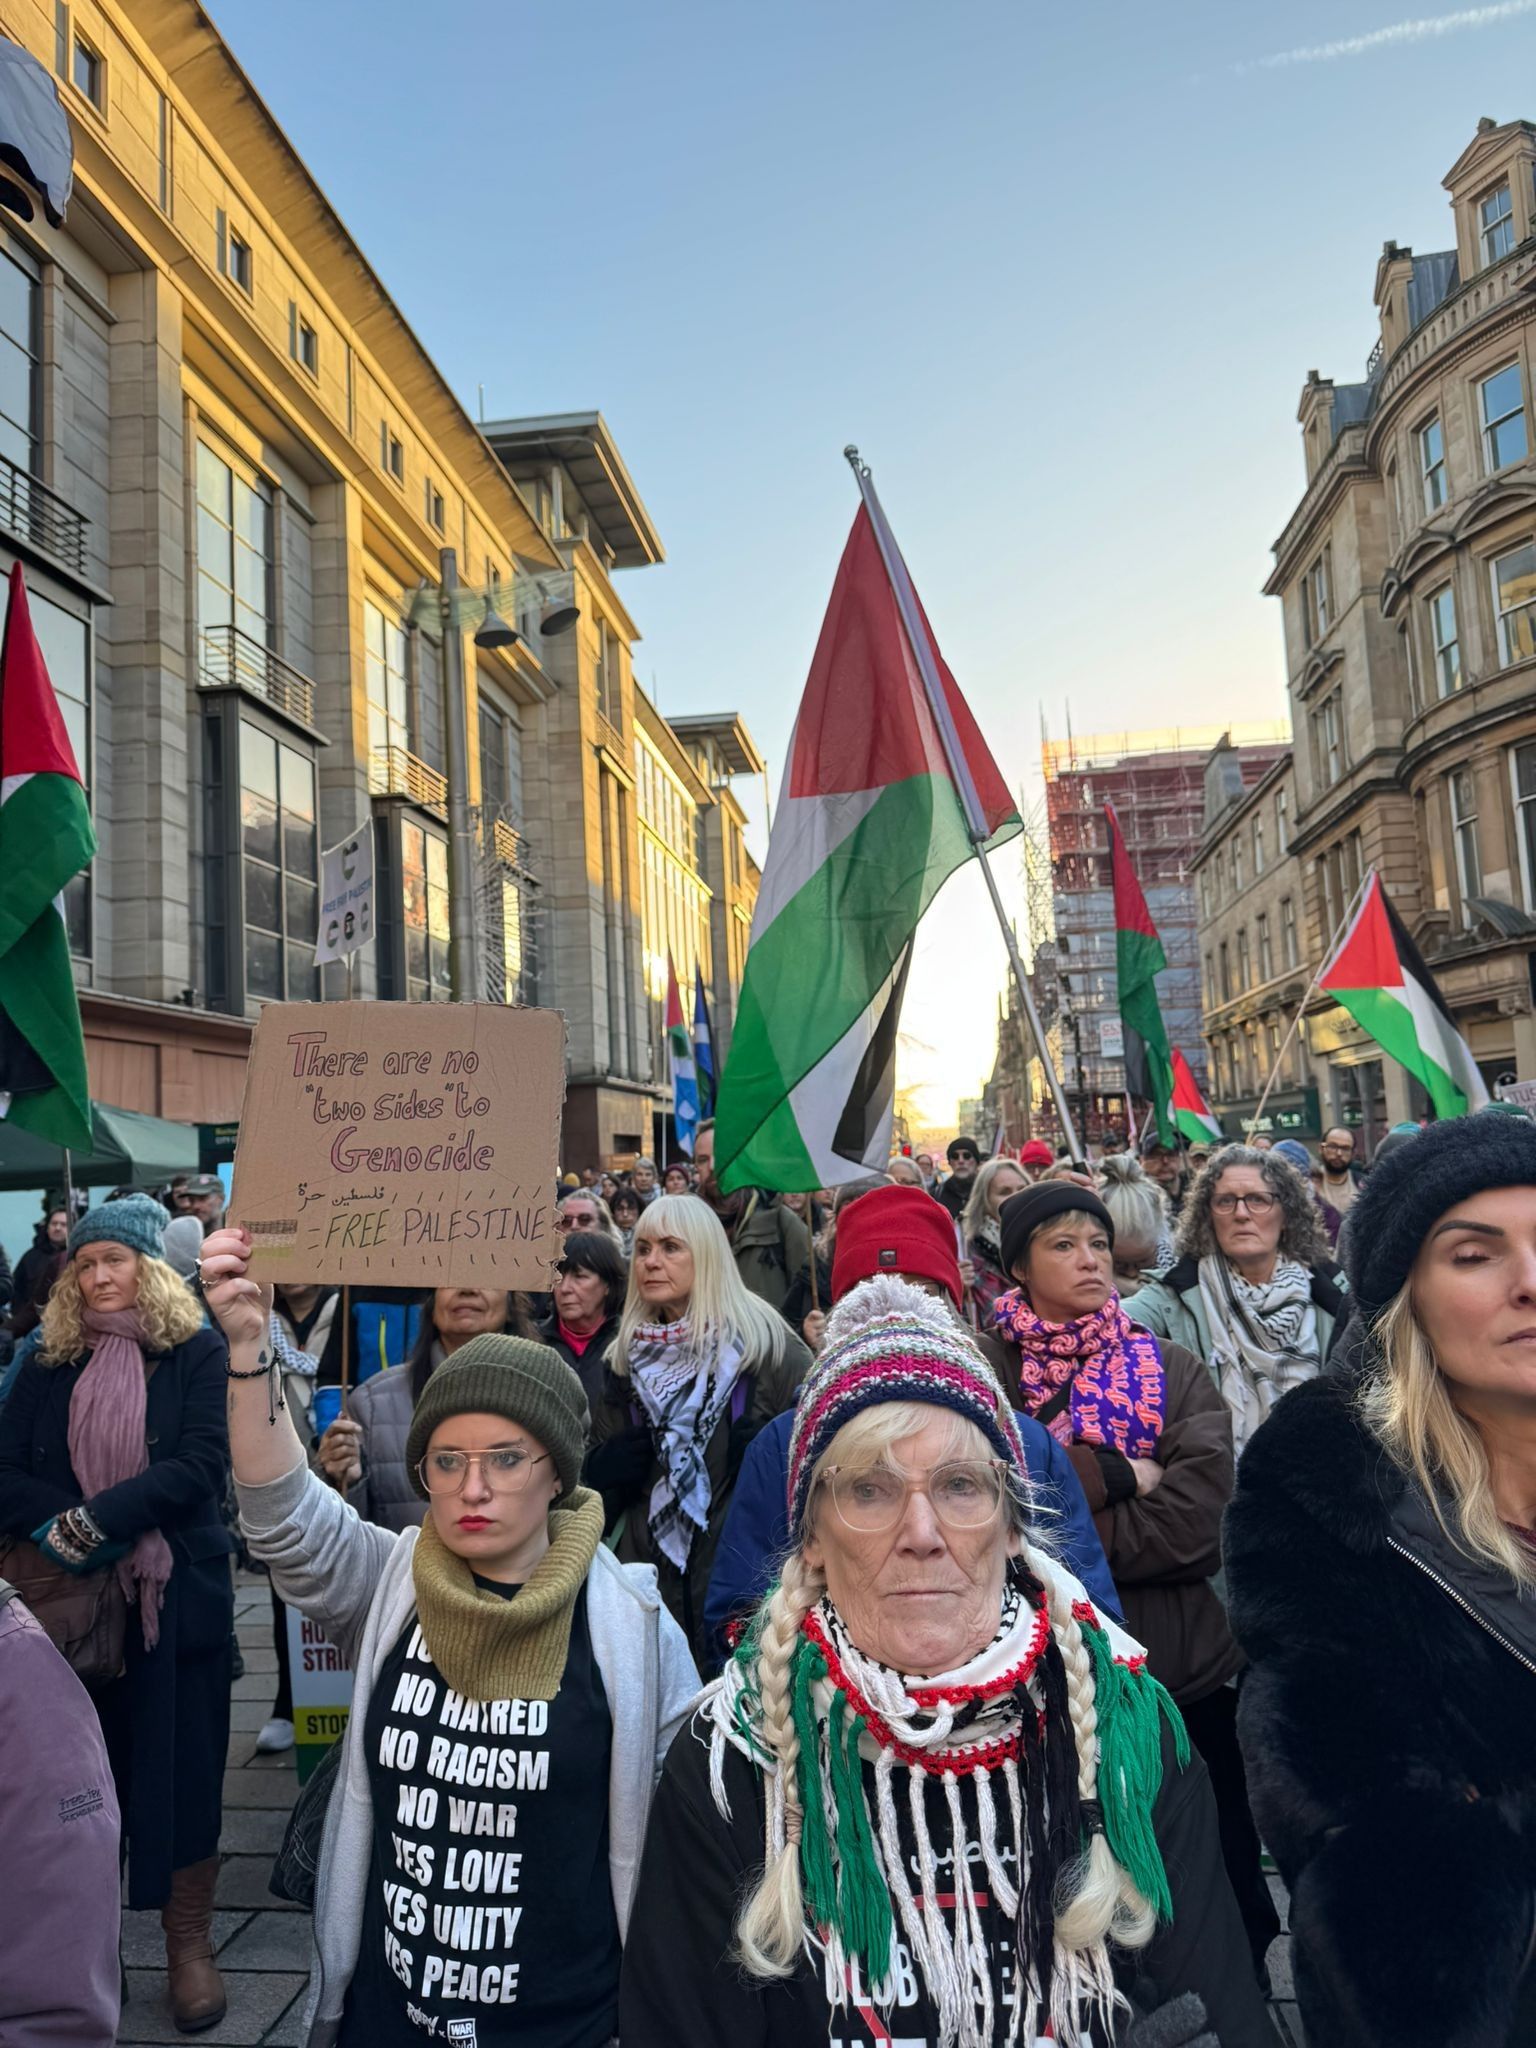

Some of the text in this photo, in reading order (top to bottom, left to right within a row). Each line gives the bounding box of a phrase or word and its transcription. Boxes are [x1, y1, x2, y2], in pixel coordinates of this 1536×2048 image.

[287, 1031, 479, 1077] There are no
[455, 1082, 490, 1118] to
[330, 1127, 494, 1173] Genocide
[331, 1186, 385, 1206] فلسطين
[325, 1206, 547, 1248] FREE PALESTINE
[301, 1620, 325, 1644] HU
[391, 1672, 437, 1717] NO
[379, 1726, 550, 1791] NO RACISM
[397, 1785, 518, 1838] NO WAR
[391, 1831, 522, 1894] YES LOVE
[383, 1879, 523, 1950] YES UNITY
[421, 1955, 520, 2004] PEACE
[450, 2022, 473, 2036] WAR
